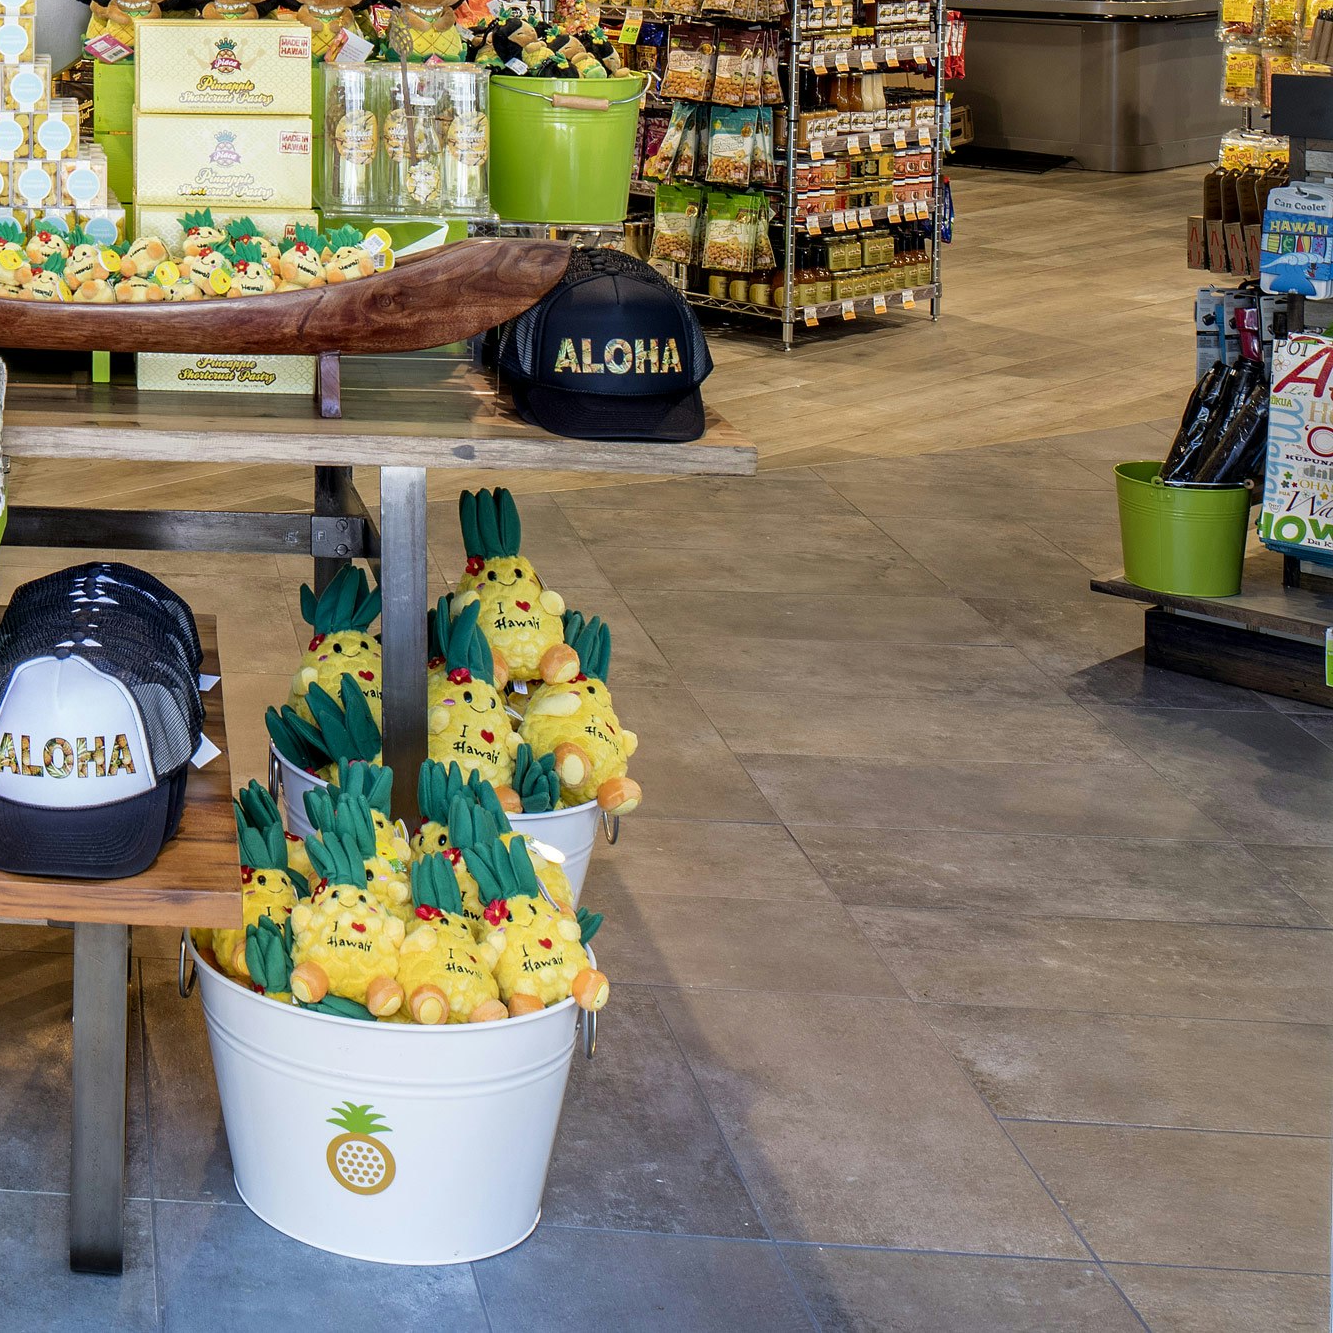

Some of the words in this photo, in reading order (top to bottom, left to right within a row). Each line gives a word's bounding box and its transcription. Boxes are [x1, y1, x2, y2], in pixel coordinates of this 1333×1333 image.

[624, 26, 639, 35] 4.99
[1228, 59, 1255, 72] enjoy
[197, 74, 255, 92] Pineapple
[179, 91, 234, 104] Shortcrust
[234, 92, 274, 107] Pastry
[1273, 197, 1291, 210] Can
[1294, 201, 1327, 212] Cooler
[1270, 220, 1329, 236] HAWAII
[297, 264, 317, 277] Hawaii
[241, 284, 264, 292] Hawaii
[553, 337, 683, 374] ALOHA
[1274, 339, 1308, 357] POI
[494, 615, 541, 632] Hawaii
[453, 741, 501, 765] Hawaii
[326, 935, 374, 953] Hawaii
[521, 956, 565, 973] Hawaii
